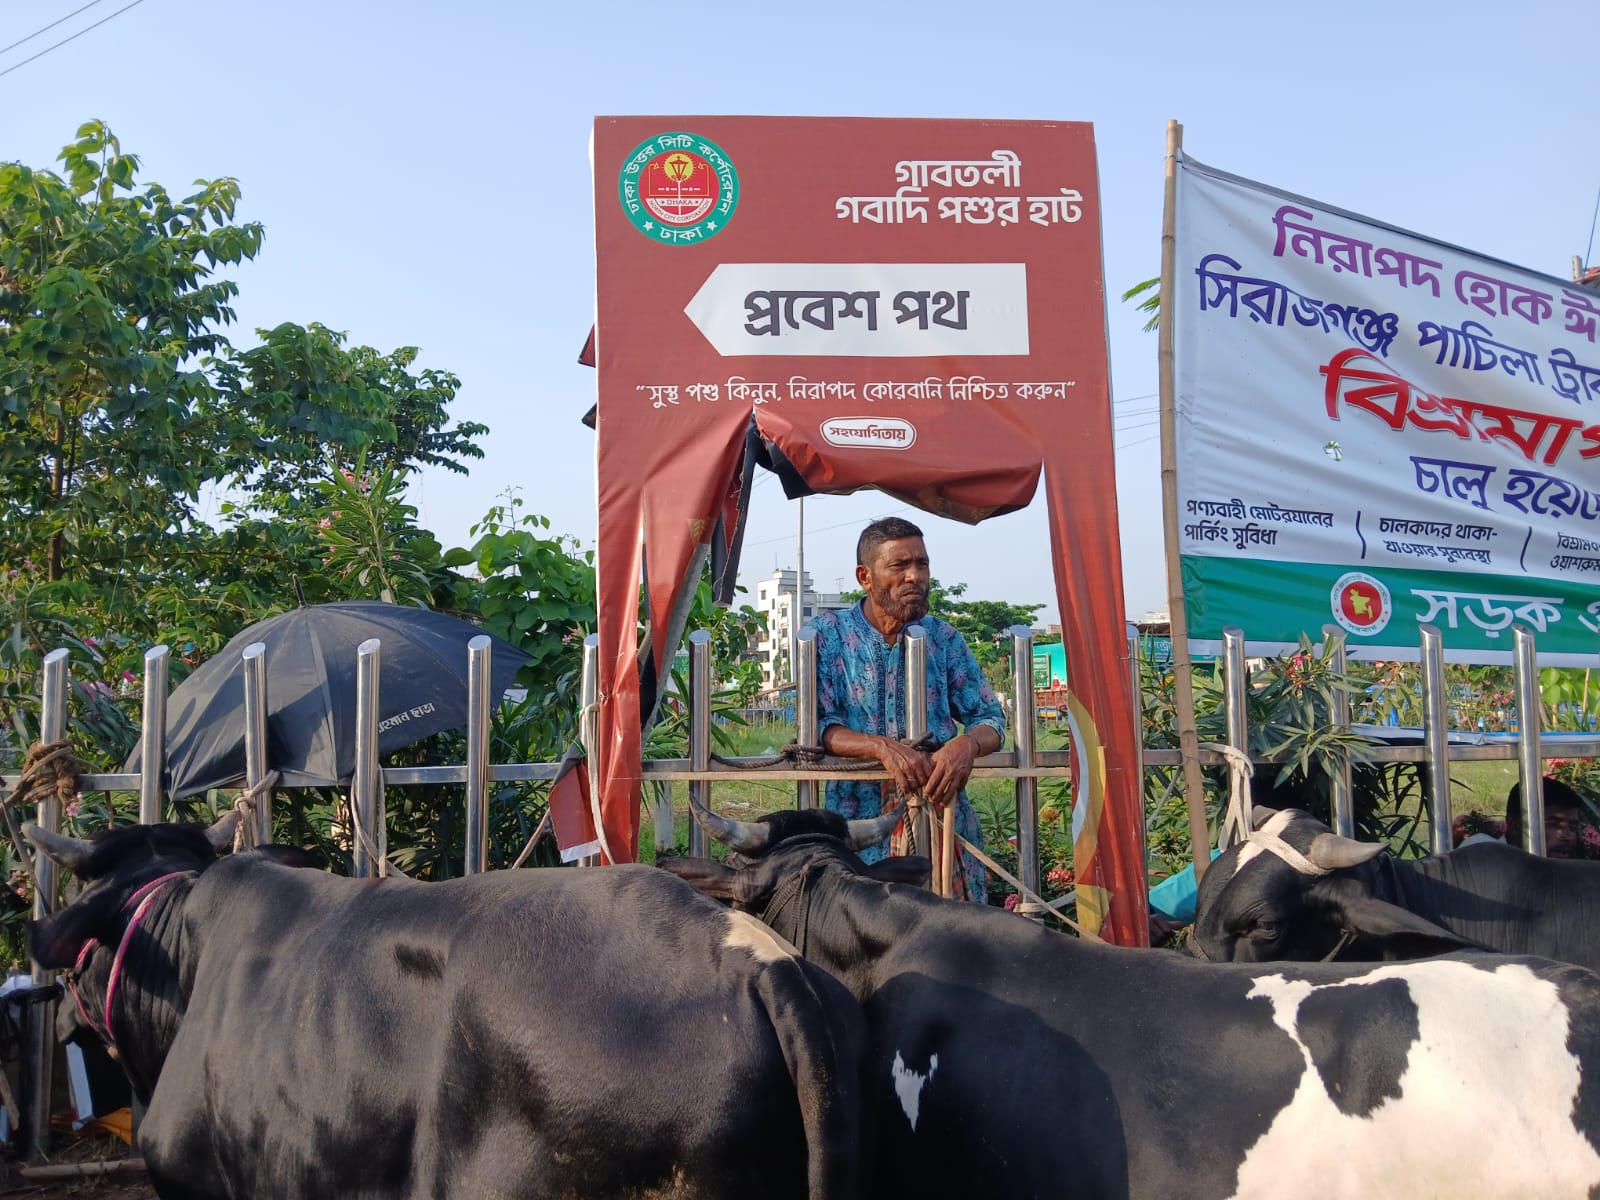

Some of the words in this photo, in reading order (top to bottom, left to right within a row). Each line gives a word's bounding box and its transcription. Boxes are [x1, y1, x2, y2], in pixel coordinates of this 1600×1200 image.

[624, 178, 640, 216] ঢাকা
[657, 134, 695, 150] সিটি
[895, 150, 1022, 187] গাবতলী
[835, 186, 930, 224] গবাদি
[937, 196, 1021, 227] পশুর
[1026, 188, 1083, 227] হাট
[660, 226, 703, 242] ঢাকা
[1272, 205, 1443, 298] নিরাপদ
[1455, 270, 1553, 325] হোক
[1560, 288, 1600, 343] ঈ
[743, 290, 881, 336] প্রবেশ
[892, 290, 970, 331] পথ
[685, 383, 719, 402] পশু
[786, 376, 856, 400] নিরাপদ
[862, 377, 943, 402] কোরবানি
[946, 376, 1009, 401] নিশ্চিত
[829, 424, 906, 442] সহযোগিতায়
[1409, 455, 1498, 514] চালু
[1186, 498, 1246, 520] পণ্যবাহী
[1250, 502, 1333, 528] মোটরযানের
[1379, 517, 1453, 539] চালকদের
[1184, 519, 1228, 542] পার্কিং
[1232, 522, 1278, 549] সুবিধা
[1411, 589, 1564, 638] সড়ক
[410, 702, 436, 718] ছাতা
